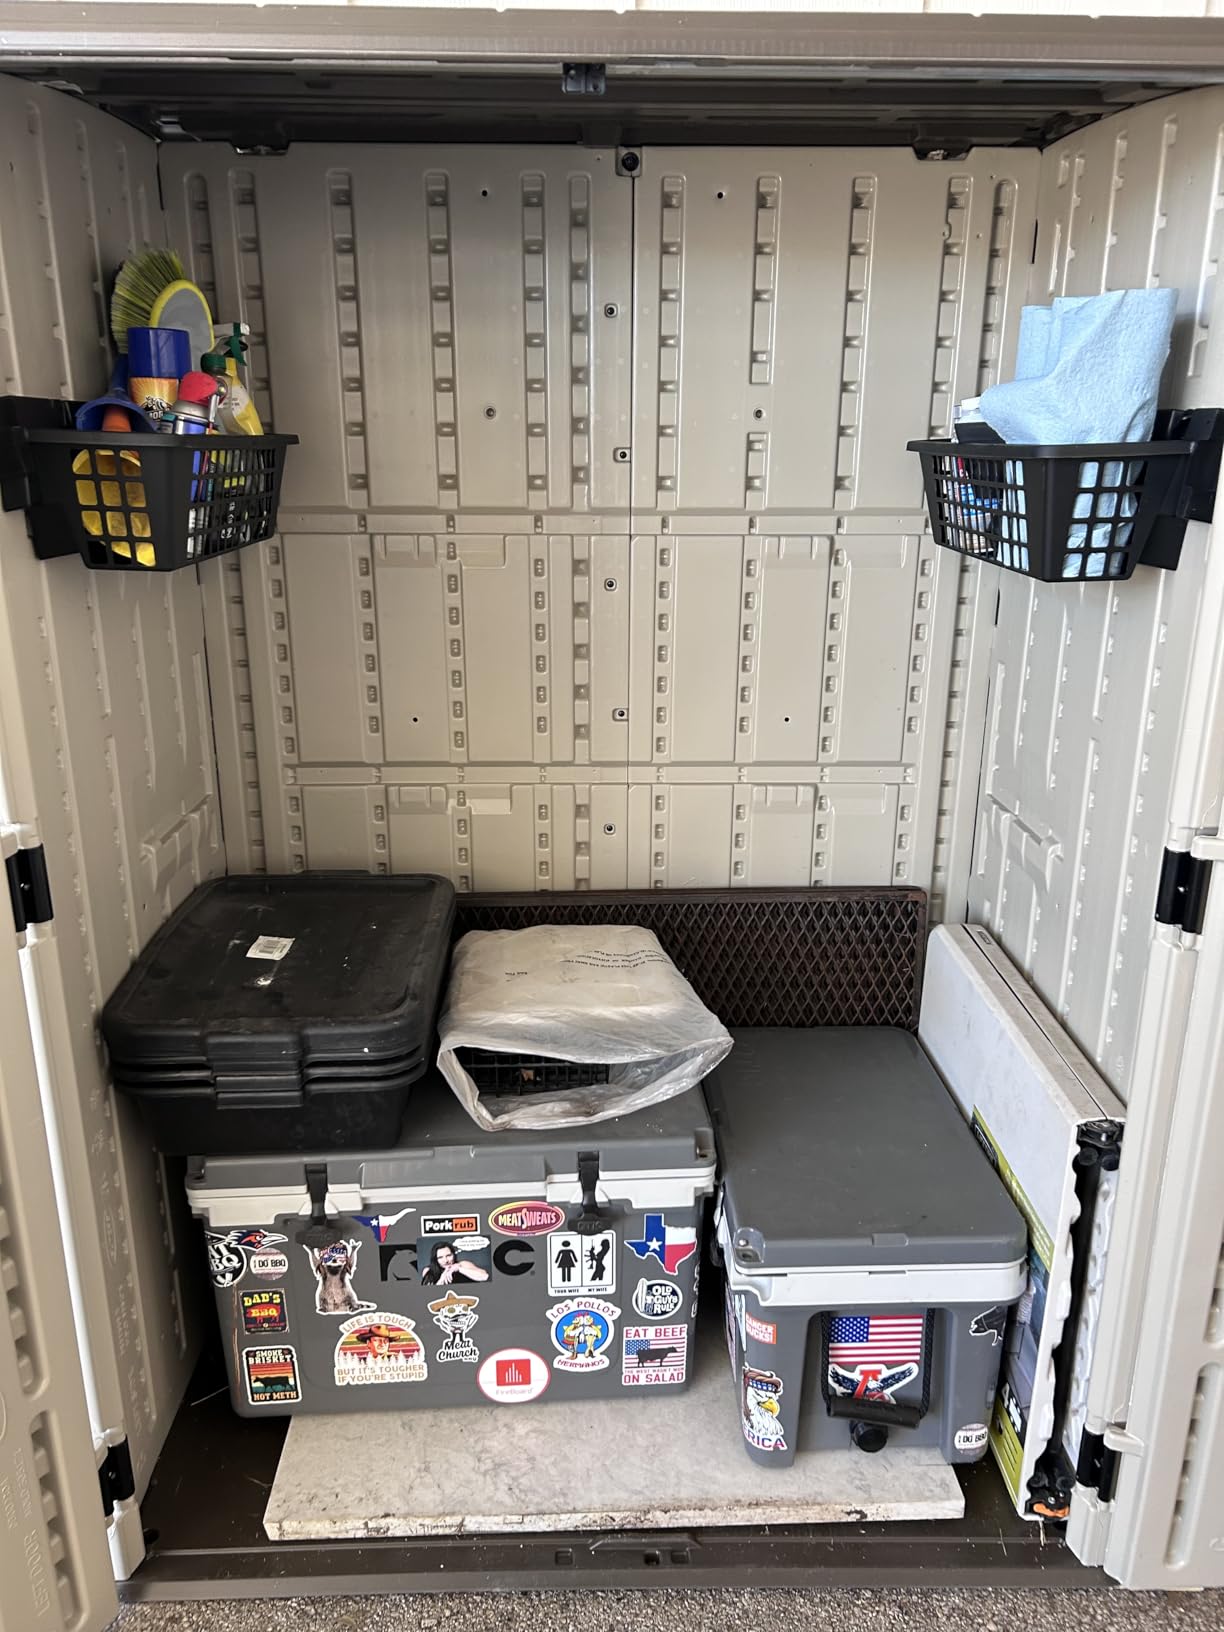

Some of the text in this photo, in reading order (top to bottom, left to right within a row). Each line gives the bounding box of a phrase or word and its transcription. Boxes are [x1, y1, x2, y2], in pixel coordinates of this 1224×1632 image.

[498, 1208, 557, 1230] MEATSWEATS
[271, 1258, 286, 1268] BBQ
[652, 1284, 672, 1296] OLD
[243, 1292, 281, 1306] DAD'S
[654, 1295, 678, 1304] GUYS
[250, 1308, 278, 1317] BBQ
[551, 1300, 616, 1318] LOS POLLOS
[654, 1302, 674, 1314] RULE
[342, 1314, 412, 1333] LIFE IS TOUGH
[626, 1326, 686, 1338] EAT BEEF
[444, 1339, 472, 1350] Meat
[248, 1354, 292, 1364] BRISKET
[255, 1350, 283, 1358] SMOKE
[438, 1348, 478, 1360] Church
[337, 1364, 425, 1376] BUT IT'S TOUGHER
[338, 1371, 425, 1384] IF YOU'RE STUPID
[624, 1372, 684, 1384] ON SALAD
[253, 1391, 297, 1401] NOT METH
